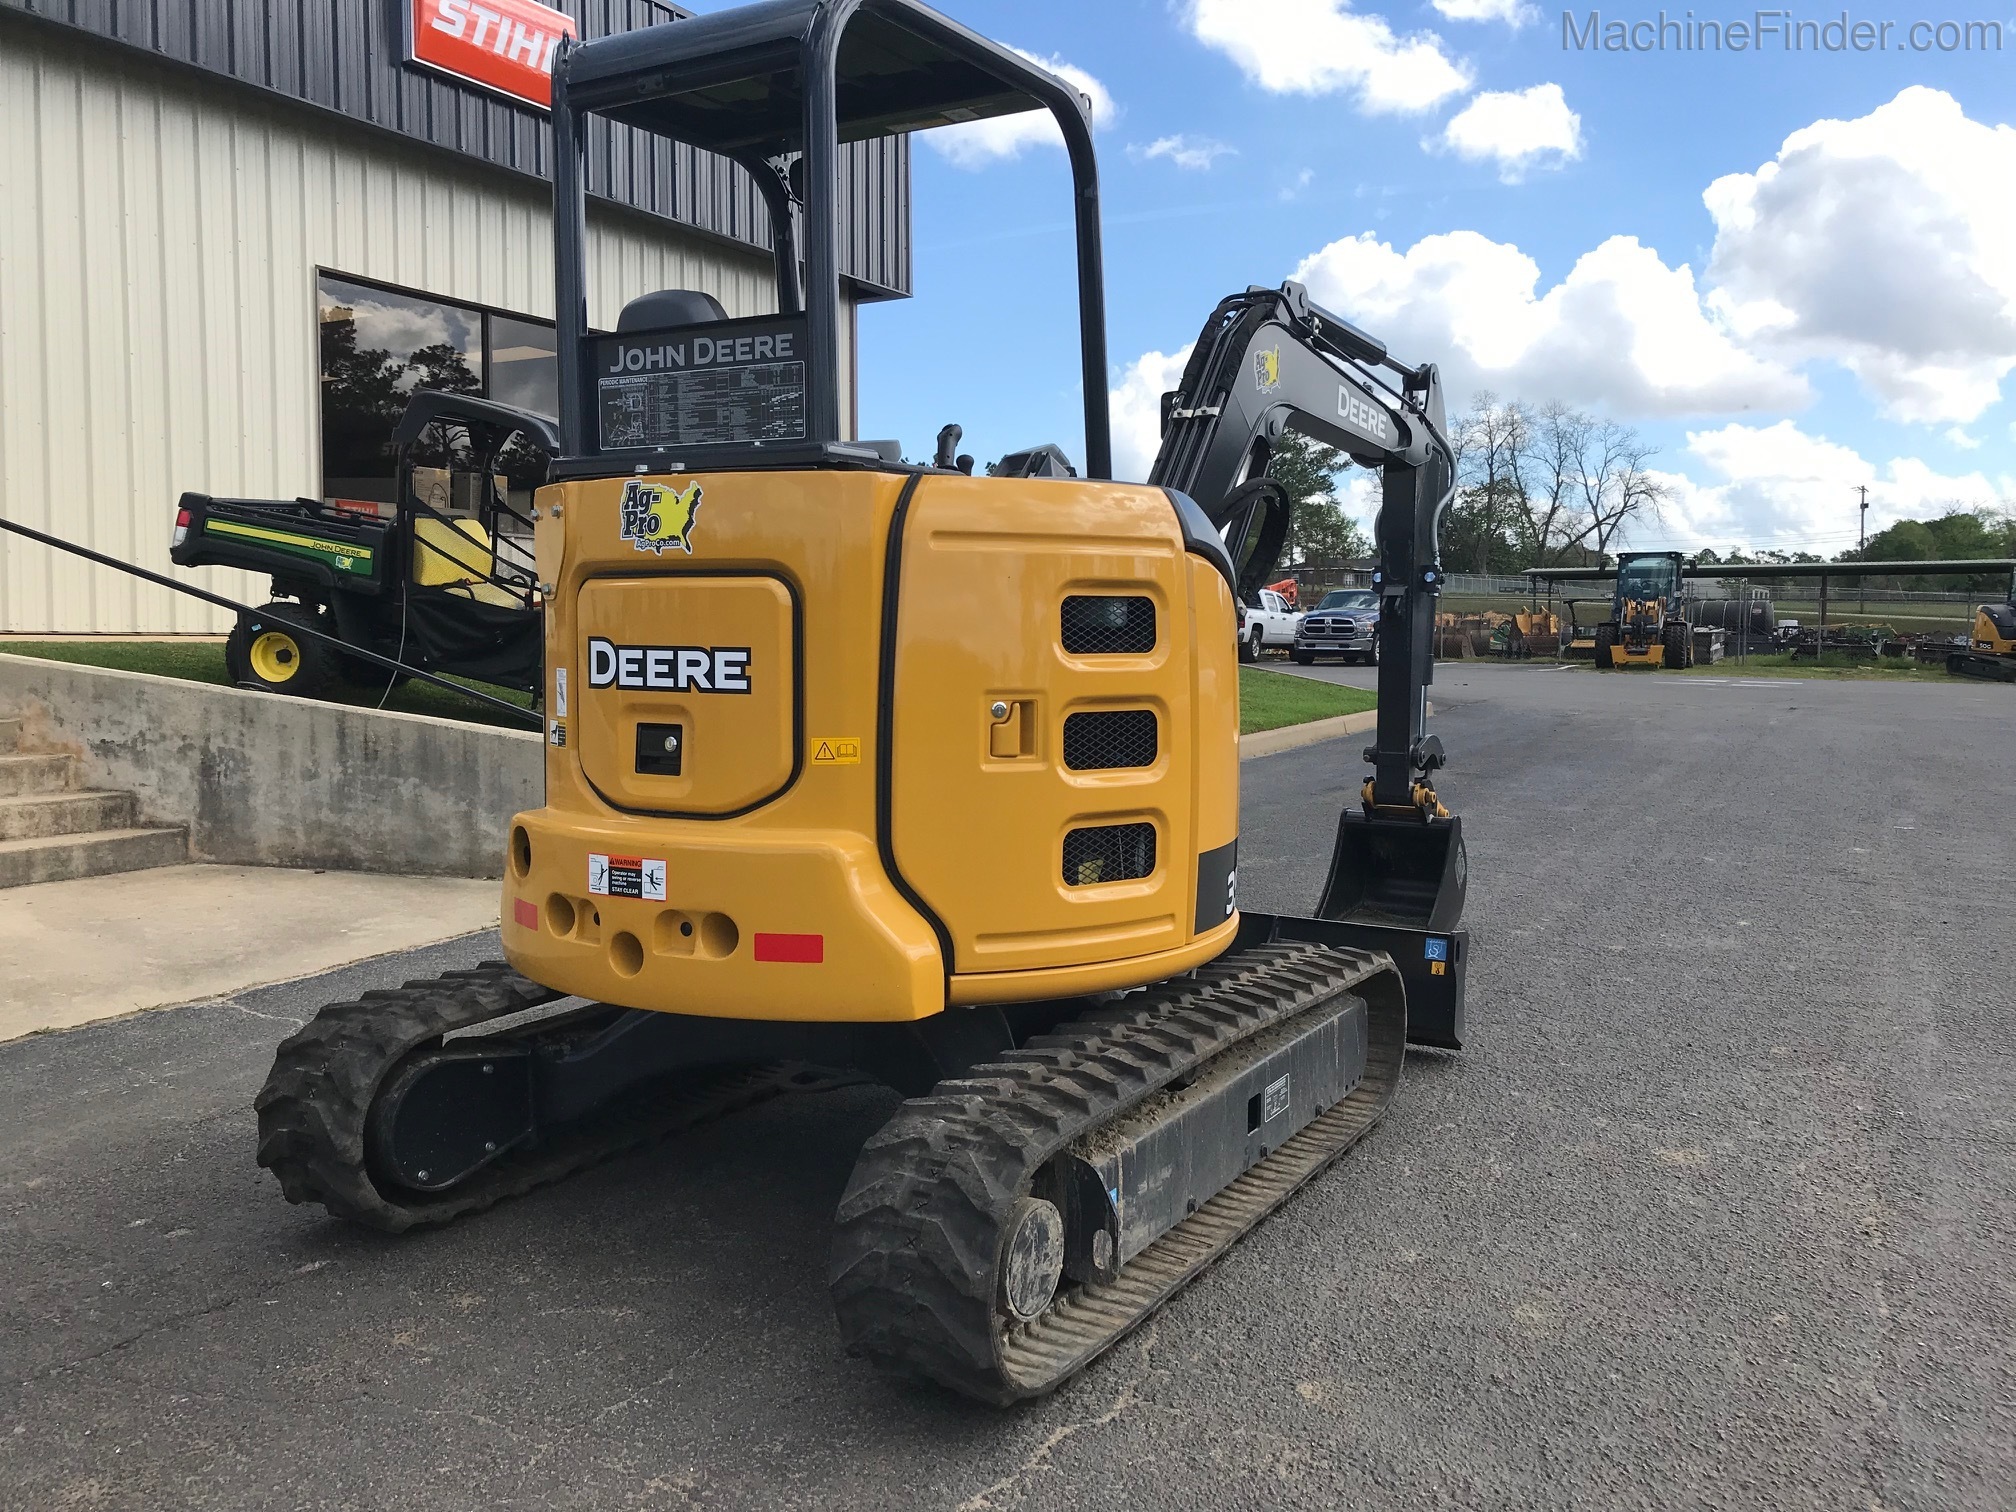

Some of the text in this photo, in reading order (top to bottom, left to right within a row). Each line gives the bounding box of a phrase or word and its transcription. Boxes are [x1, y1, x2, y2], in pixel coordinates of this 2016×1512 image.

[609, 333, 794, 373] JOHN DEERE
[600, 379, 619, 387] PERIODIC
[619, 376, 648, 385] MAINTENANCE
[1256, 370, 1270, 387] Pro
[1337, 383, 1387, 440] DEERE
[623, 482, 661, 515] Ag-
[622, 511, 661, 538] Pro
[310, 541, 361, 557] JOHN DEERE
[636, 539, 681, 549] AgProCo.com
[590, 640, 748, 690] DEERE
[614, 858, 642, 867] WARNING
